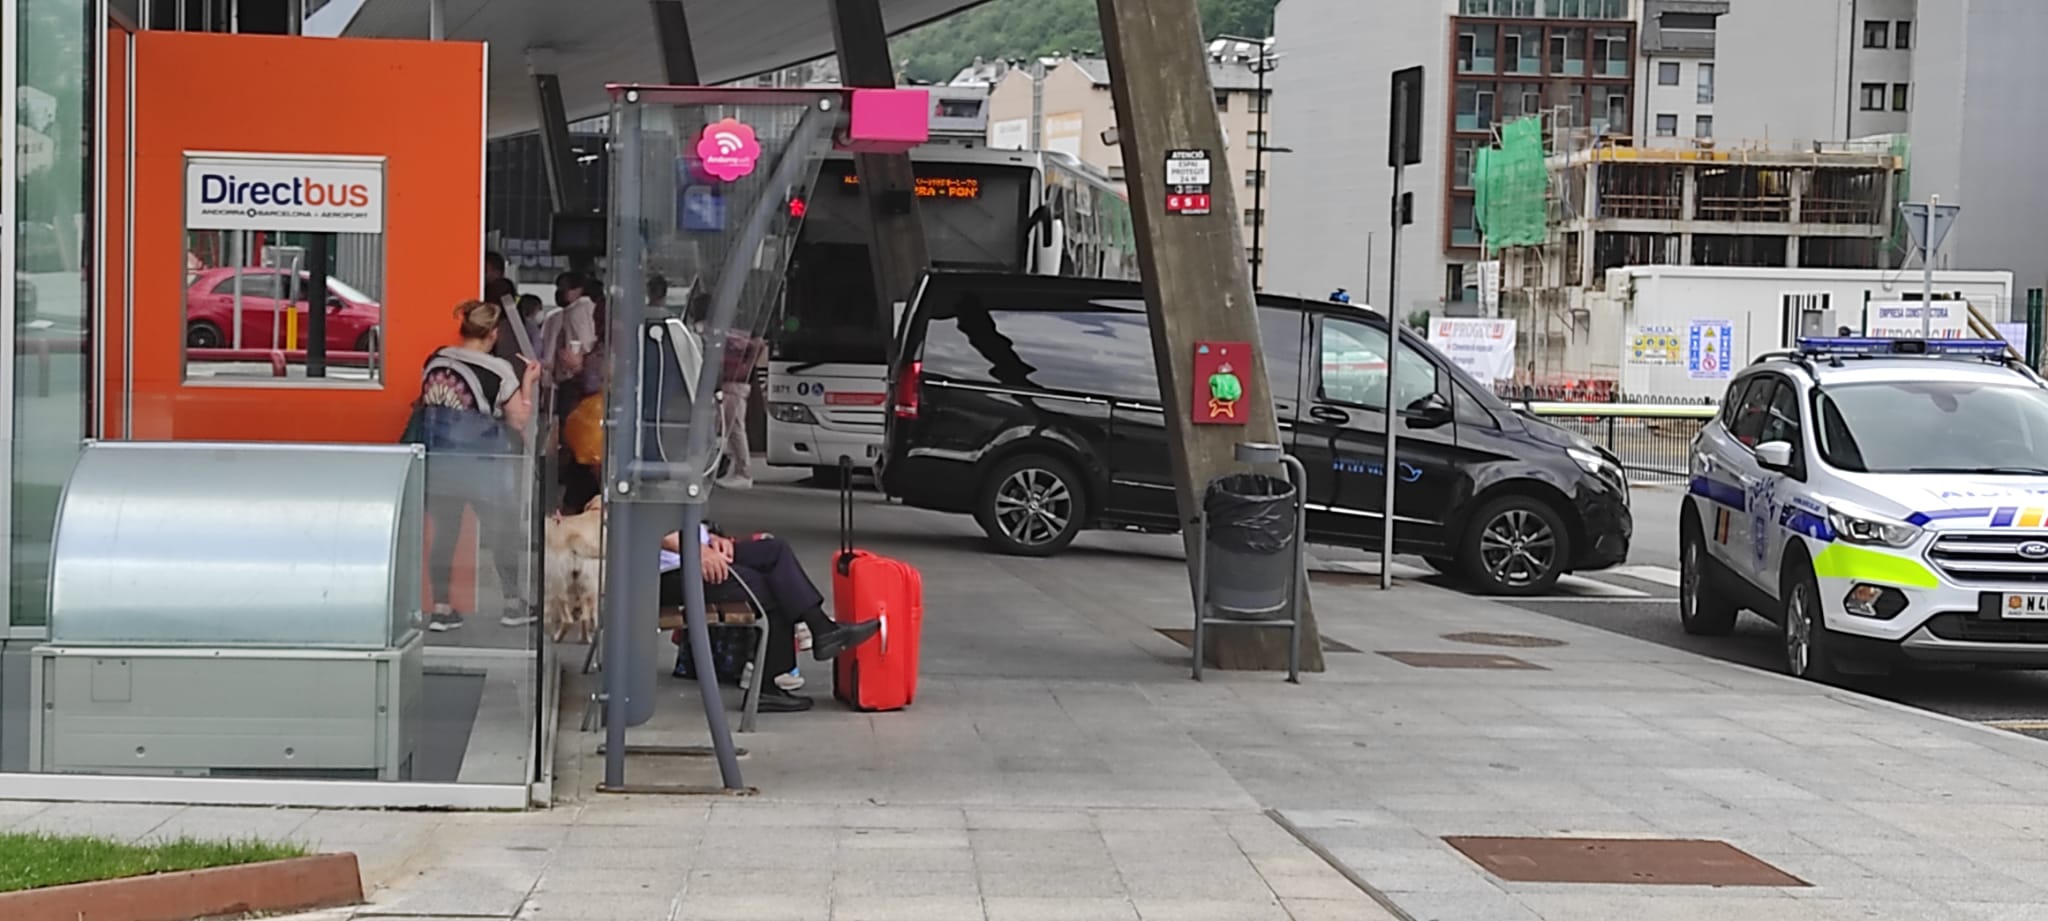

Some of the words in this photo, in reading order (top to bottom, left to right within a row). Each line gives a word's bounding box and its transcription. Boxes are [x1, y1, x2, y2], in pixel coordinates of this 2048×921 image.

[201, 174, 369, 207] Directbus
[257, 210, 312, 218] BARCELONA
[1905, 307, 1949, 318] CONSTCTORA
[1368, 466, 1384, 476] VAL
